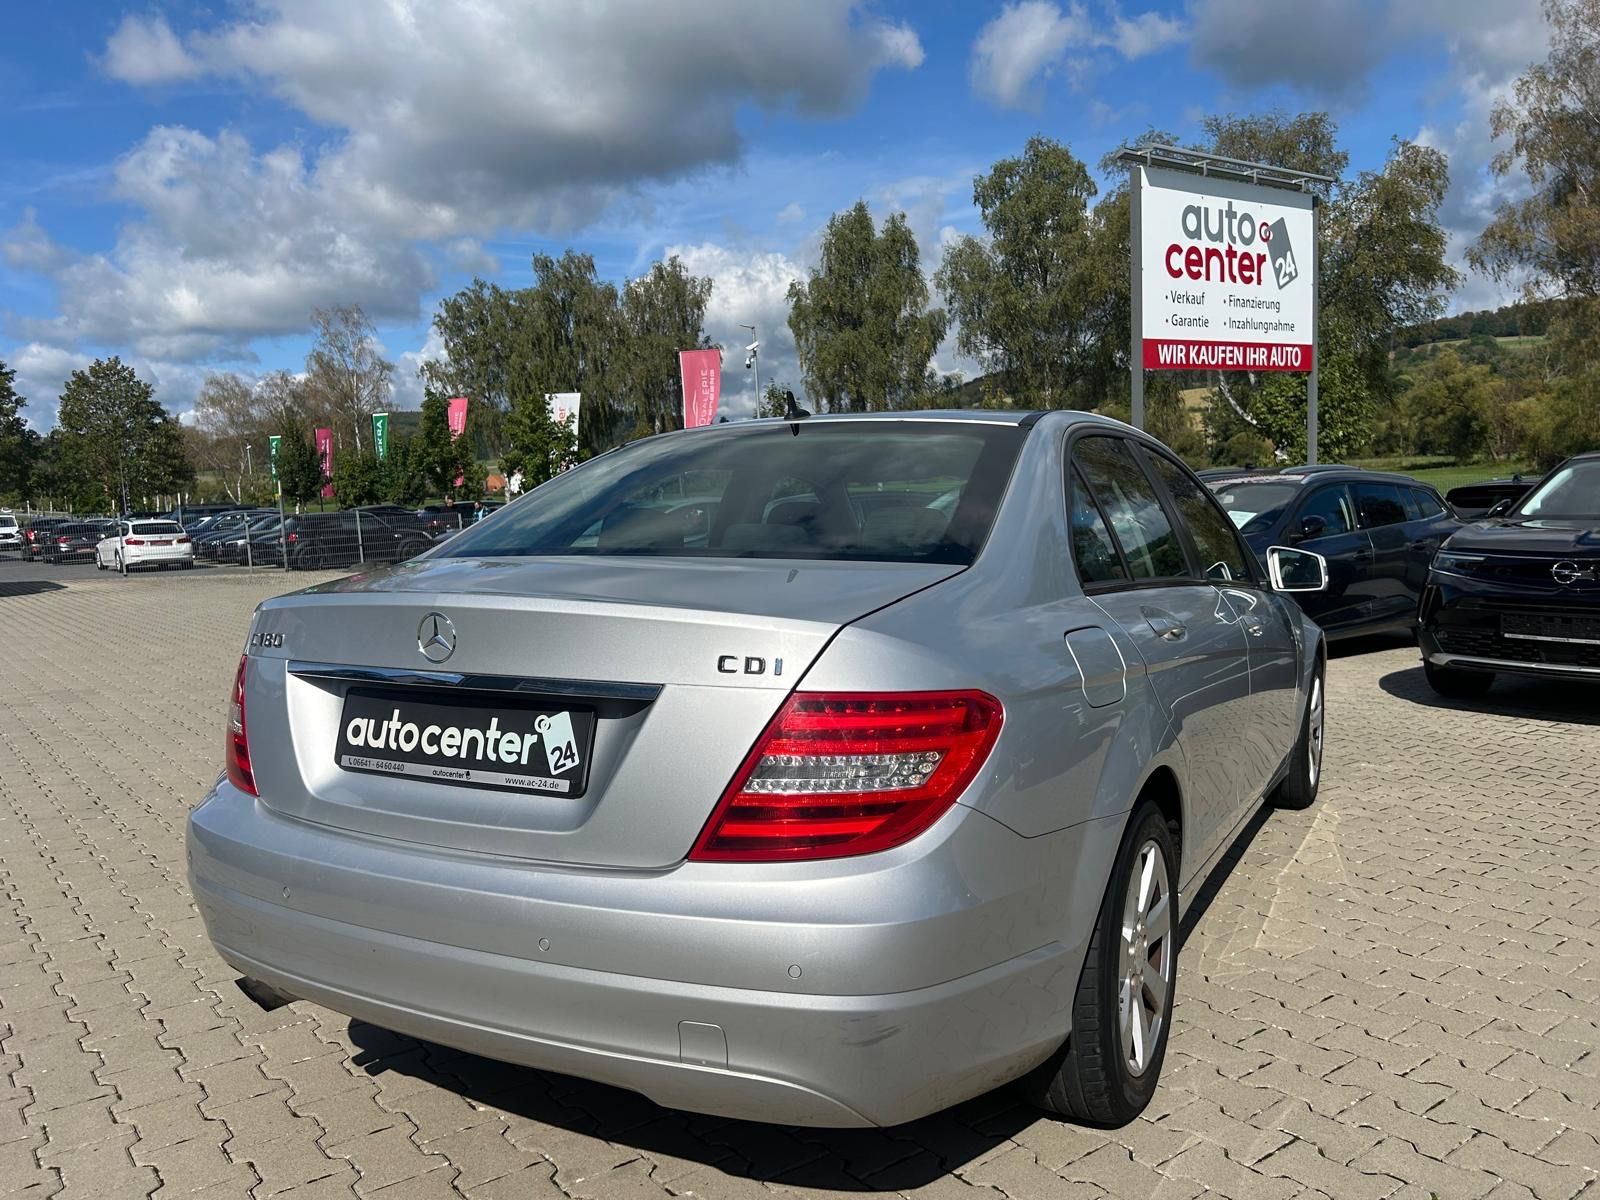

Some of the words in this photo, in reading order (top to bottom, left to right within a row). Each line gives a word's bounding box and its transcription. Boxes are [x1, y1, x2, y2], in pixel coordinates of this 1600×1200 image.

[1181, 200, 1256, 246] auto
[1165, 242, 1266, 286] center
[1275, 251, 1296, 282] 24
[1170, 290, 1205, 306] Verkauf
[1228, 294, 1281, 313] Finanzierung
[1171, 313, 1209, 328] Garantie
[1228, 317, 1295, 334] Inzahlungnahme
[1157, 344, 1187, 365] WIR
[1189, 345, 1243, 366] KAUFEN
[1246, 346, 1268, 366] IHR
[1269, 346, 1302, 367] AUTO
[717, 655, 783, 676] CDI
[346, 709, 538, 765] autocenter
[352, 757, 371, 768] 06641
[550, 741, 576, 772] 24
[432, 769, 465, 779] autocenter
[504, 777, 560, 790] www.ac-24.de
